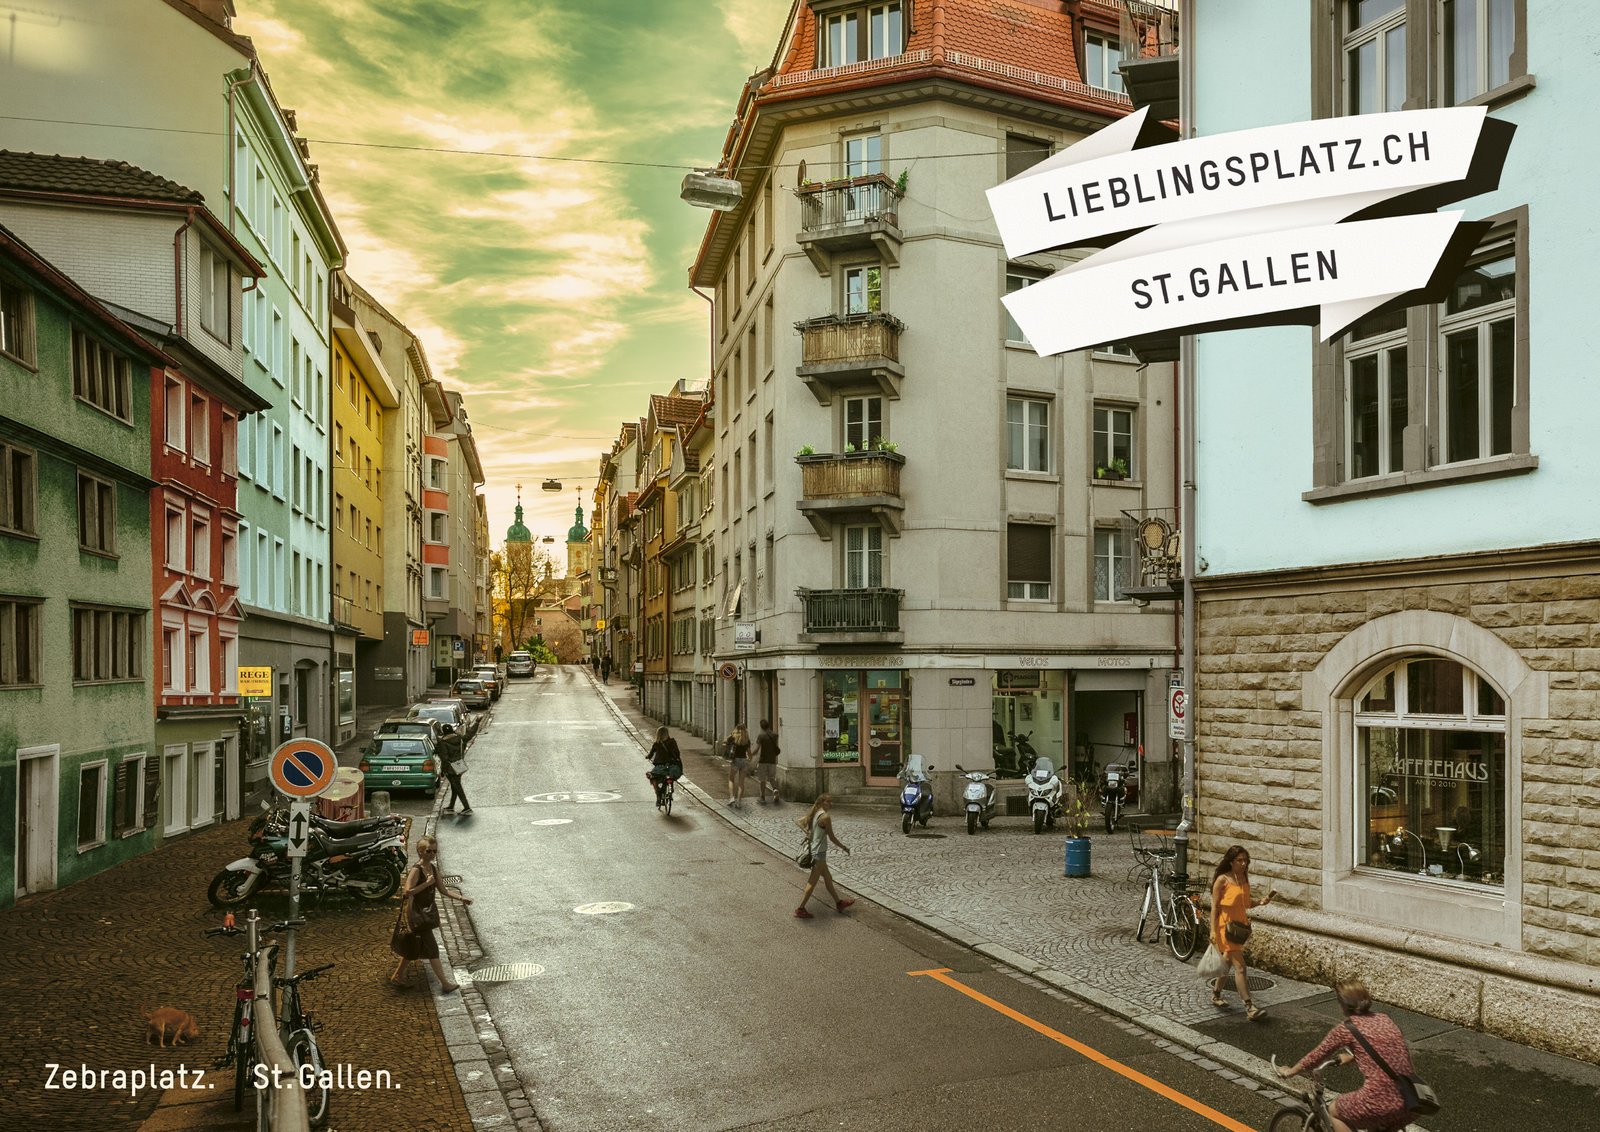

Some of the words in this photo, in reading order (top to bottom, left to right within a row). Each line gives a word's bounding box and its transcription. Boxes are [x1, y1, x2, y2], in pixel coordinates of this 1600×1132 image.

[1097, 656, 1131, 667] MOTOS
[1388, 758, 1489, 780] KAFFEEHAUS
[1415, 779, 1437, 787] ANNO
